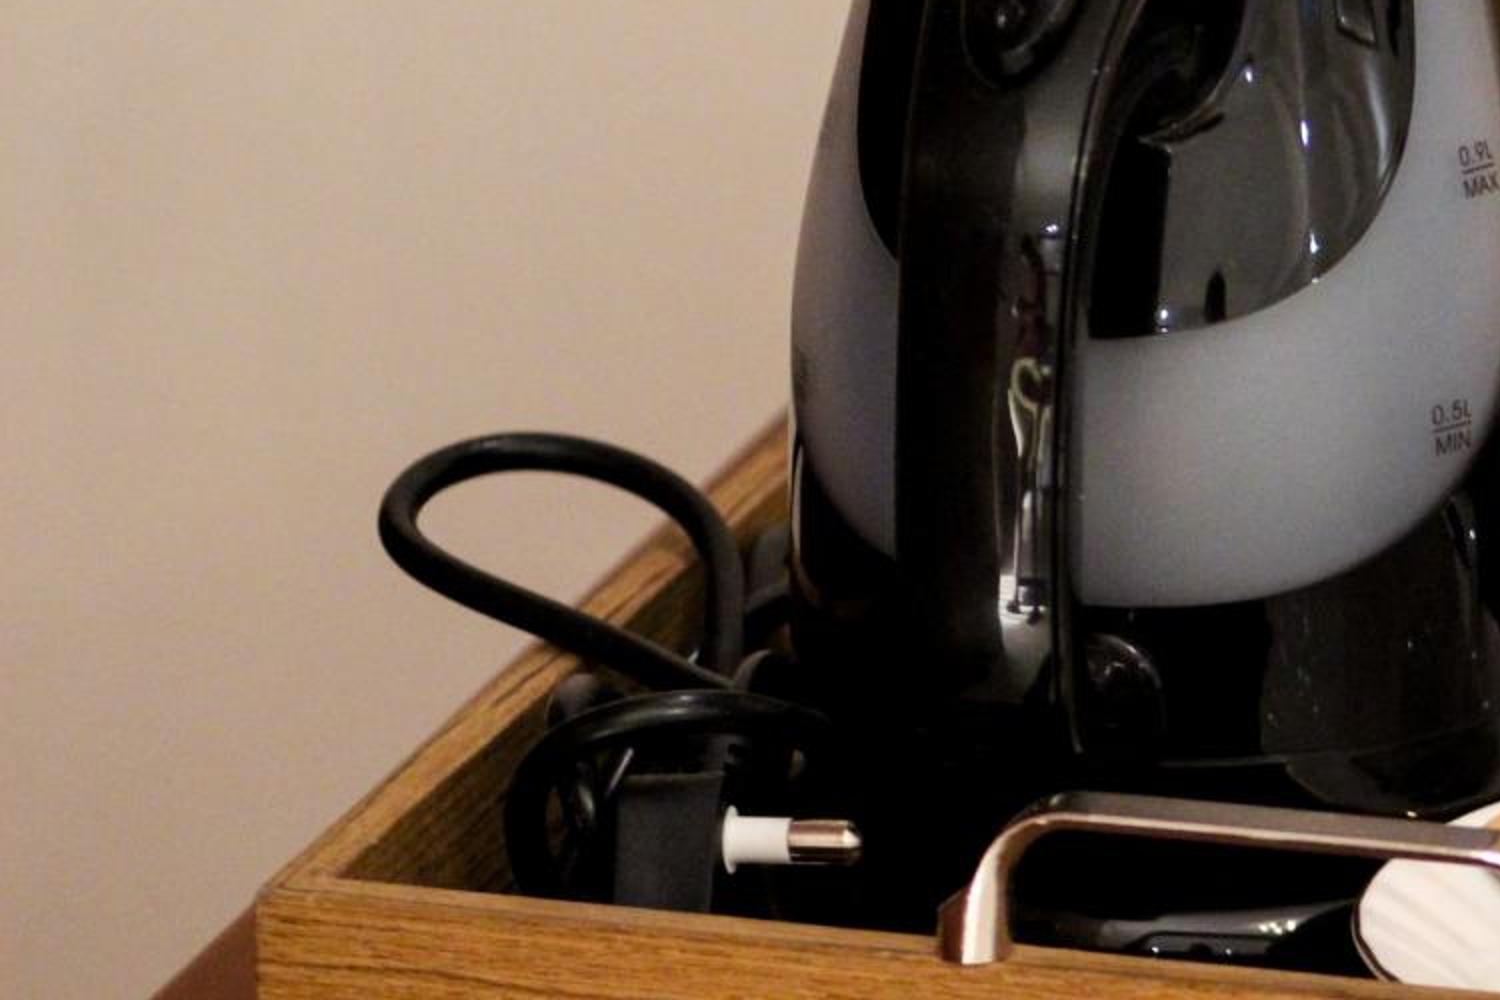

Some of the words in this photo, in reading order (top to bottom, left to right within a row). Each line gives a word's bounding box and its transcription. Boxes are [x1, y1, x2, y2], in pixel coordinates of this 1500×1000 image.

[1458, 139, 1493, 167] 0.9L
[1463, 171, 1500, 200] MAX
[1431, 398, 1472, 426] 0.5L
[1435, 430, 1472, 457] MIN
